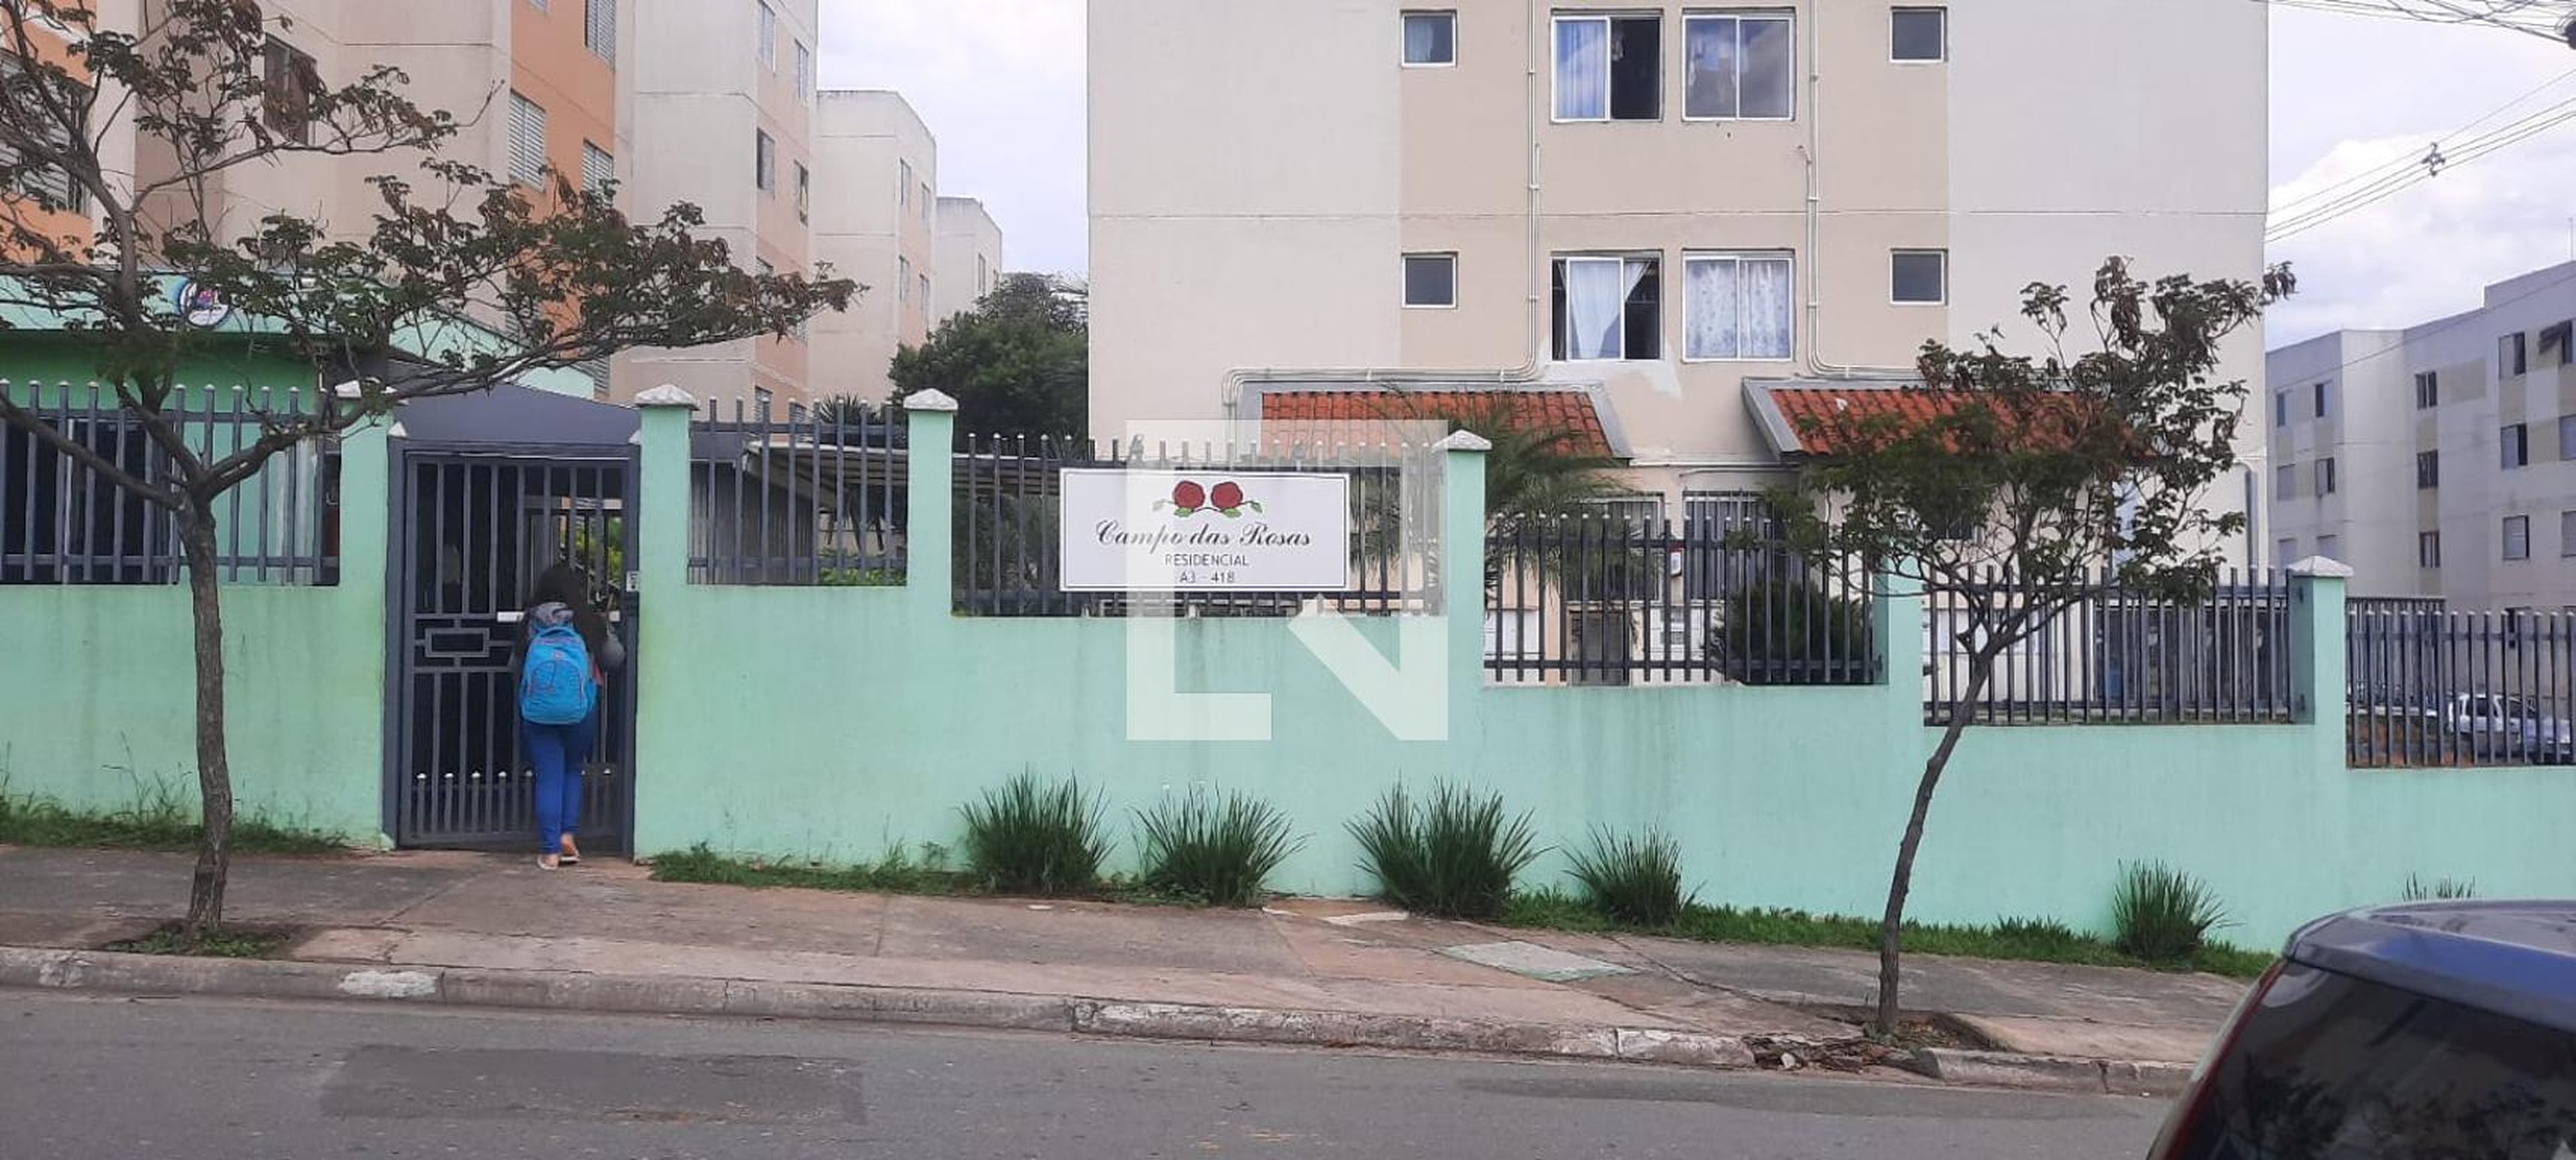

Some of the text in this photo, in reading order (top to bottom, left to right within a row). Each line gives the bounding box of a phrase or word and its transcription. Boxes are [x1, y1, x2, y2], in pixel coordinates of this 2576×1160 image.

[1095, 519, 1311, 554] Campo das Rosas
[1165, 553, 1250, 567] RESIDENCIAL
